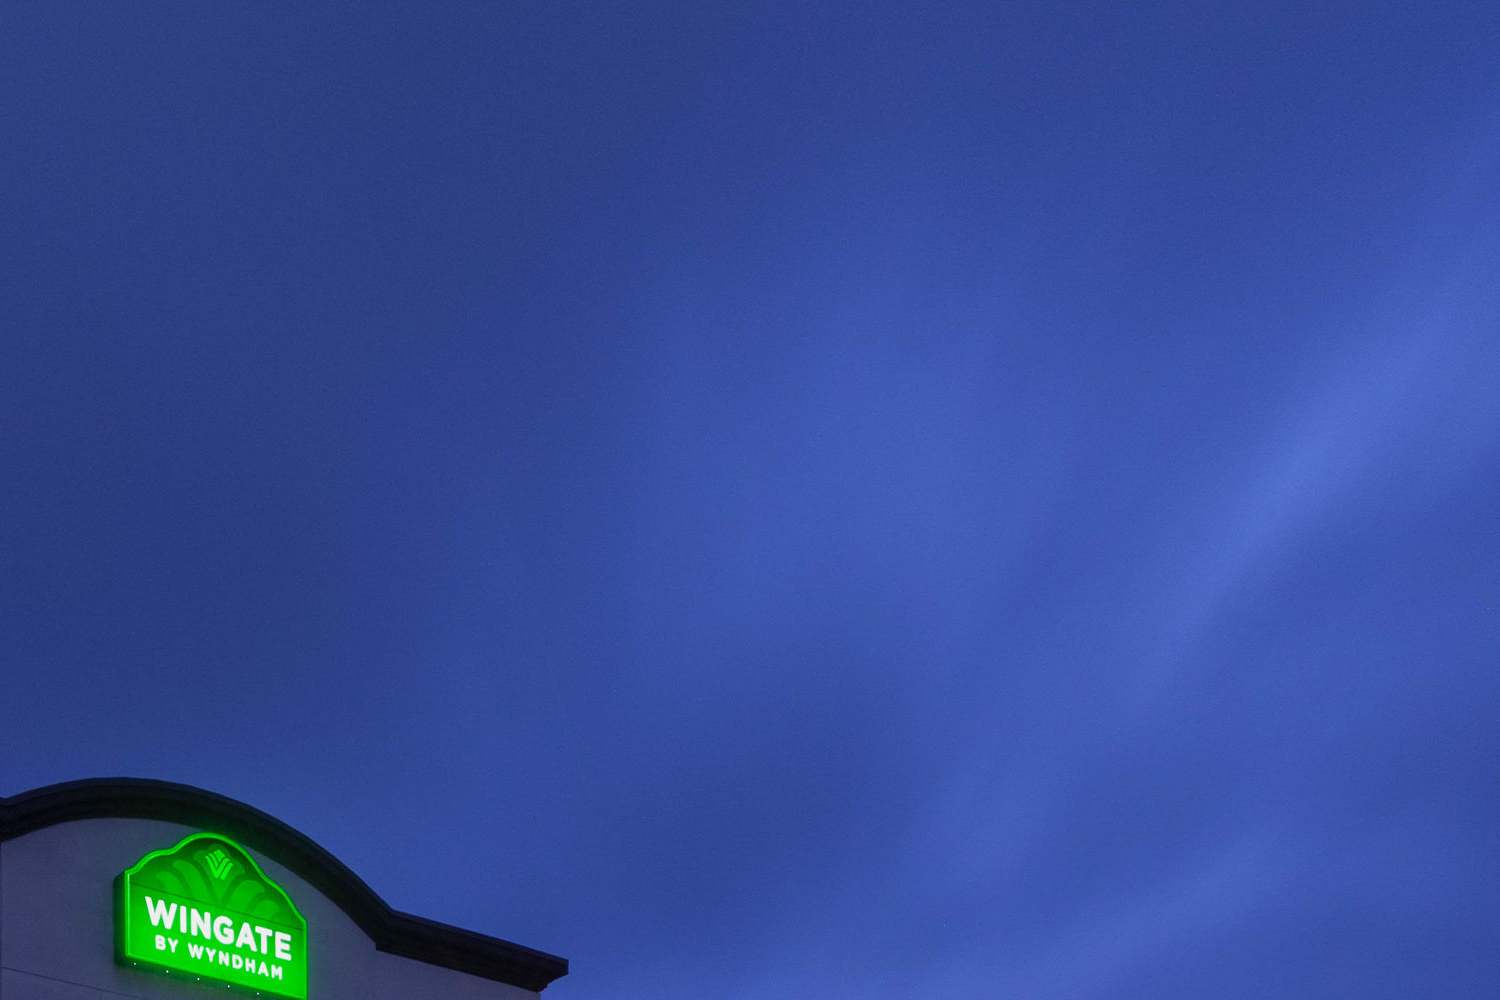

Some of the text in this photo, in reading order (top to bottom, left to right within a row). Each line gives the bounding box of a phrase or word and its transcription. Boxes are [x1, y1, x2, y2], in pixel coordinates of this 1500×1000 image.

[145, 896, 292, 961] WINGATE
[155, 934, 283, 981] BY WYNDHAM
